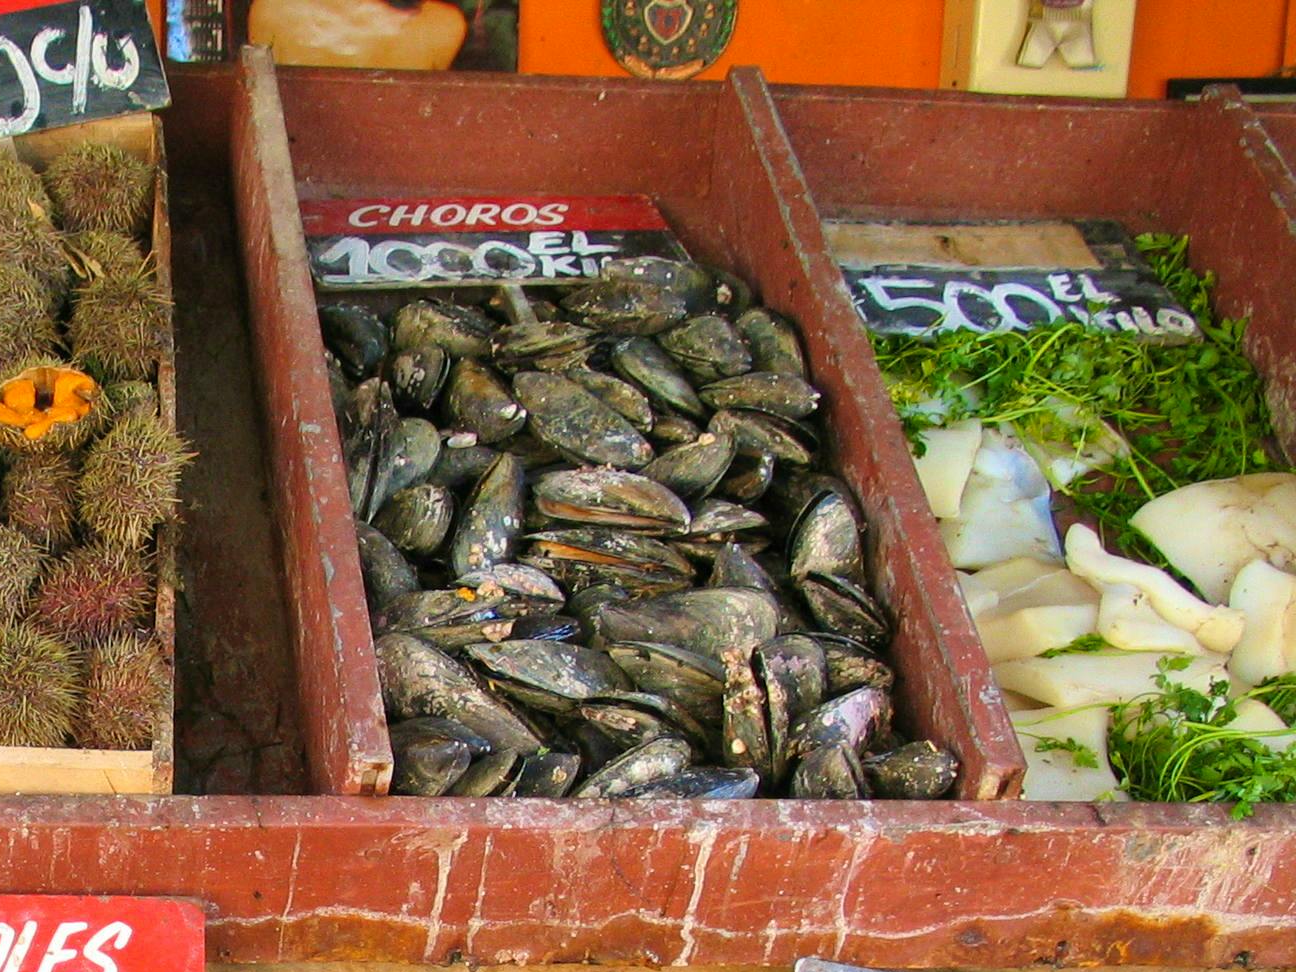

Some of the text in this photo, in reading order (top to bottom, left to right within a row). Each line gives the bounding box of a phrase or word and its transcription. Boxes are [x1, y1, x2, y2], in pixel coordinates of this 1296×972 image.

[348, 203, 570, 228] CHOROS
[528, 230, 622, 256] EL
[319, 236, 536, 281] 1000
[1047, 273, 1122, 303] EL
